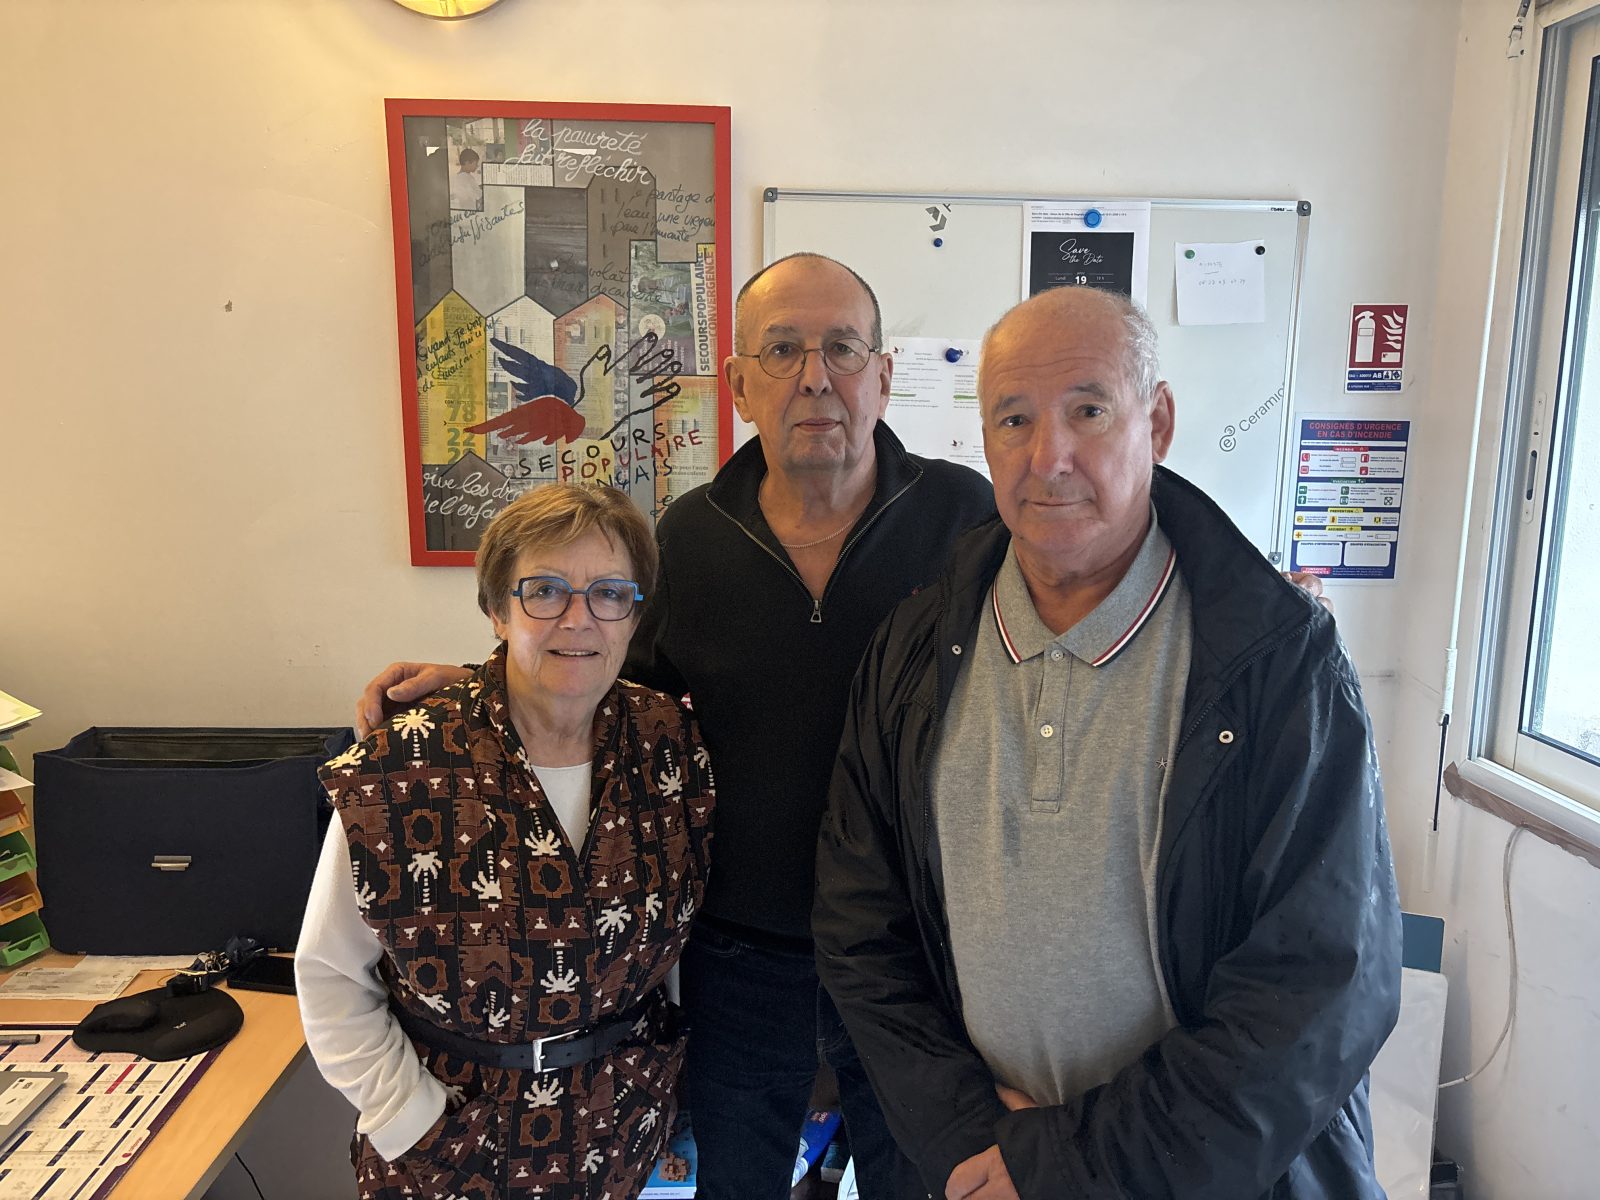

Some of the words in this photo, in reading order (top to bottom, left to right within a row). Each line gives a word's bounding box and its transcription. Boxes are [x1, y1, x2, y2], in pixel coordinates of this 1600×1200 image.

[522, 118, 548, 141] la
[552, 127, 648, 156] pauvreté
[645, 184, 701, 214] partage
[657, 212, 680, 225] une
[1059, 238, 1090, 260] Save
[1068, 254, 1080, 263] the
[1082, 253, 1104, 266] Date
[1075, 275, 1088, 285] 19
[704, 250, 718, 338] CONVERGENCE
[460, 337, 474, 355] qui
[1309, 422, 1355, 430] CONSIGNES
[1358, 423, 1402, 431] D'URGENCE
[1317, 430, 1329, 438] EN
[518, 423, 665, 476] SECOURS
[562, 429, 703, 481] POPULAIRE
[458, 471, 491, 497] les
[596, 458, 673, 490] NÇAIS
